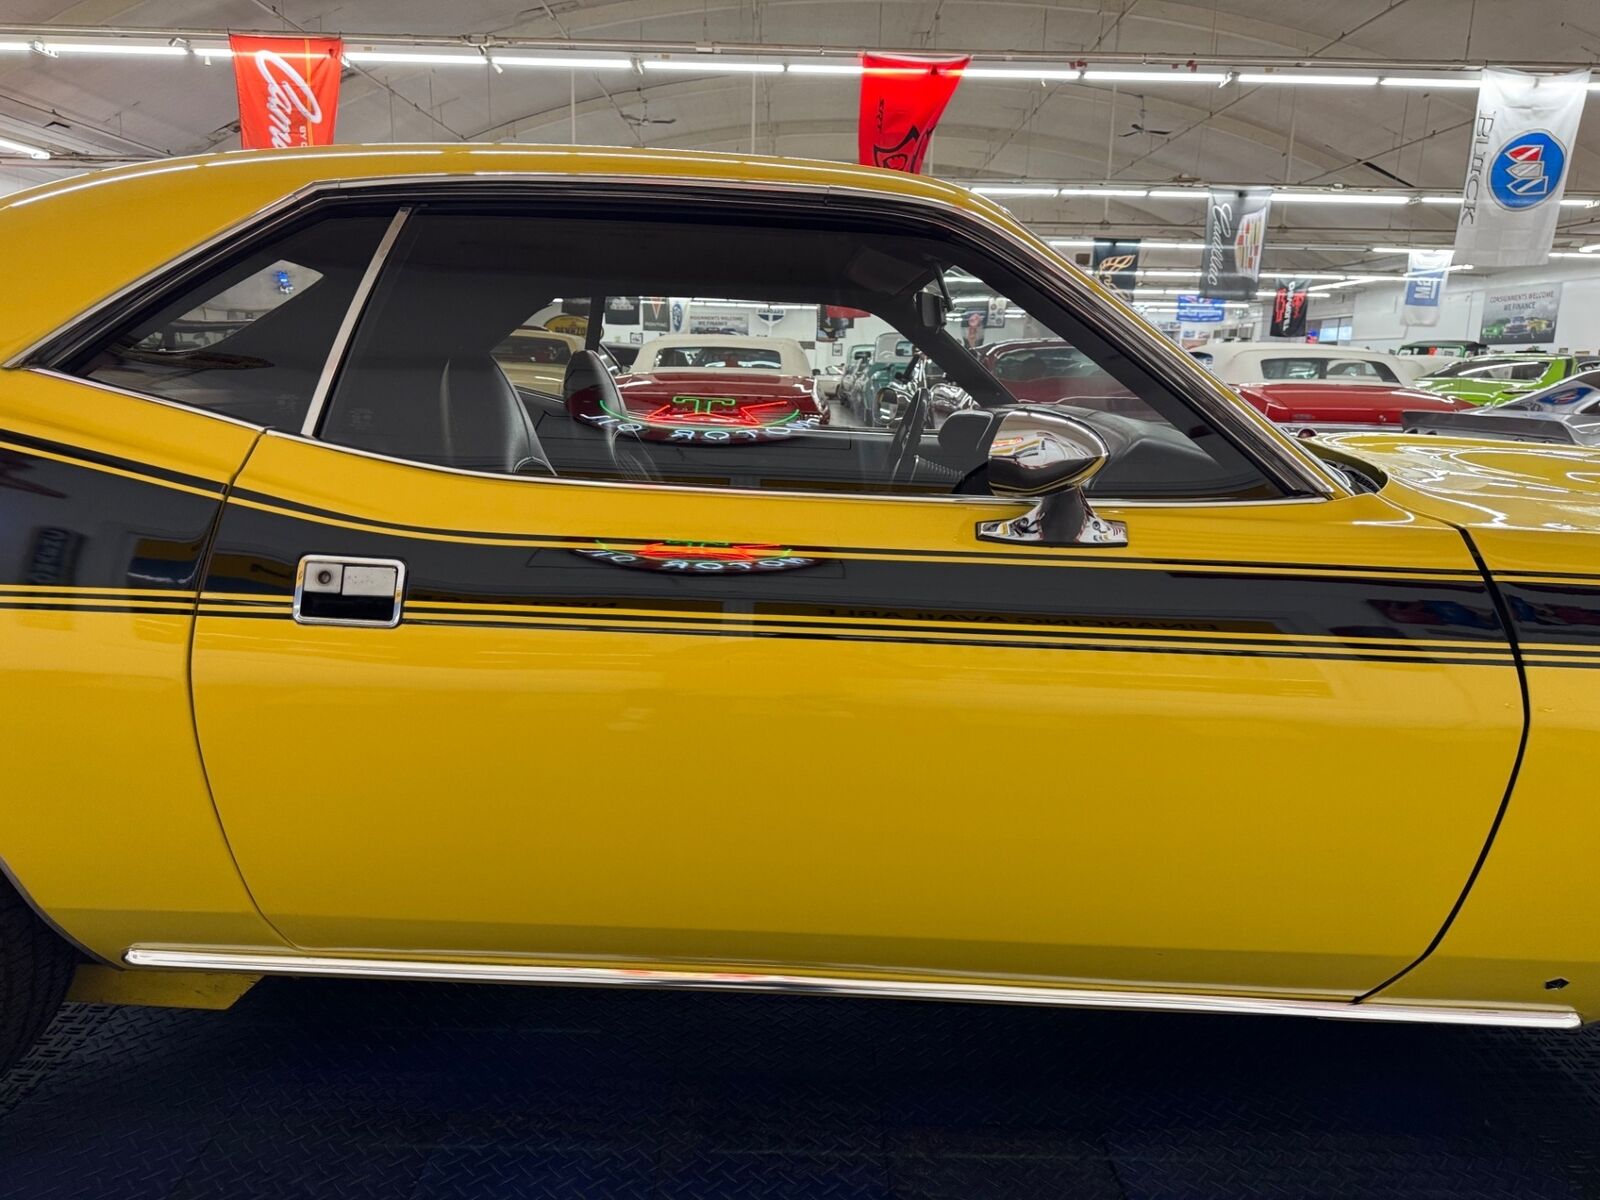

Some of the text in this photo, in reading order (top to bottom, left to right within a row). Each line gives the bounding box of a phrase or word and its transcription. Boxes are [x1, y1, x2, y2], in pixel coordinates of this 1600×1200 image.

[1460, 110, 1497, 226] BUICK
[1207, 202, 1233, 286] Cadillac
[1503, 301, 1536, 311] WE FINANCE
[1528, 290, 1554, 299] WELCOME
